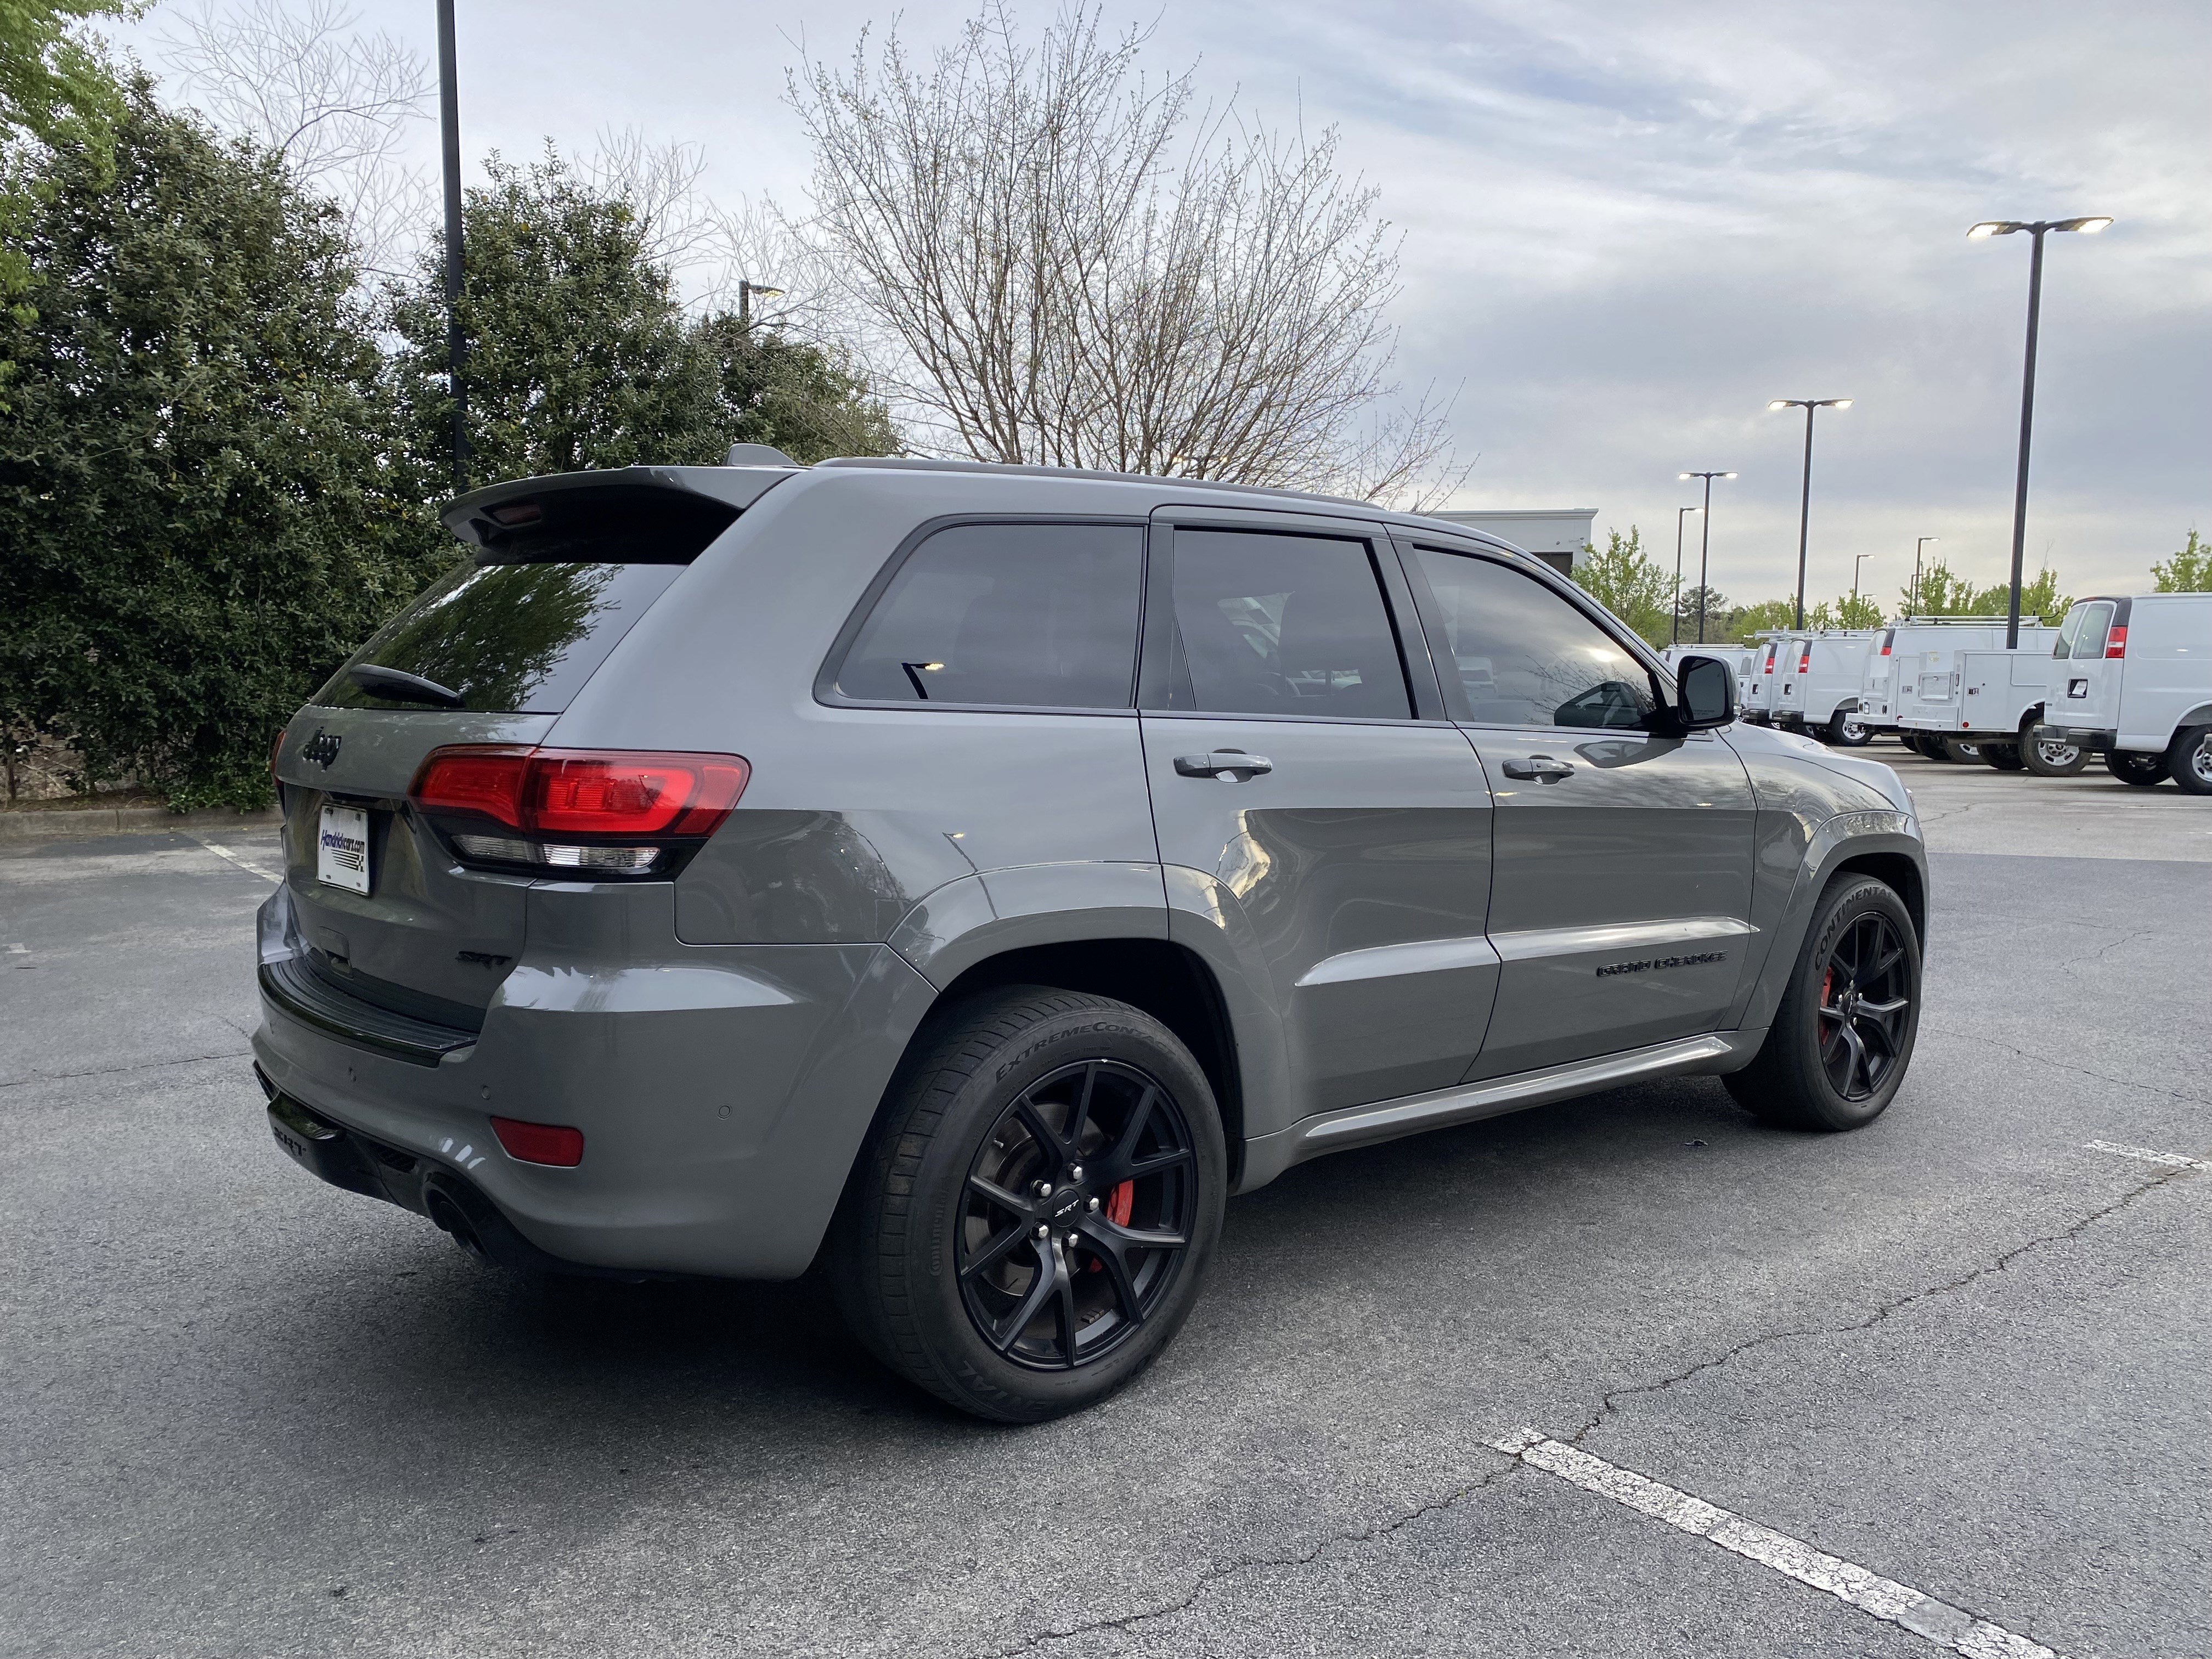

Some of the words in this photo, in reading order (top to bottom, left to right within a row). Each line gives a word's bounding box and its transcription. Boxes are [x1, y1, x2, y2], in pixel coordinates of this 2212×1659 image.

[1596, 960, 1651, 977] GRAND
[1655, 950, 1729, 969] CHEROKEE
[1054, 1199, 1080, 1218] SRT
